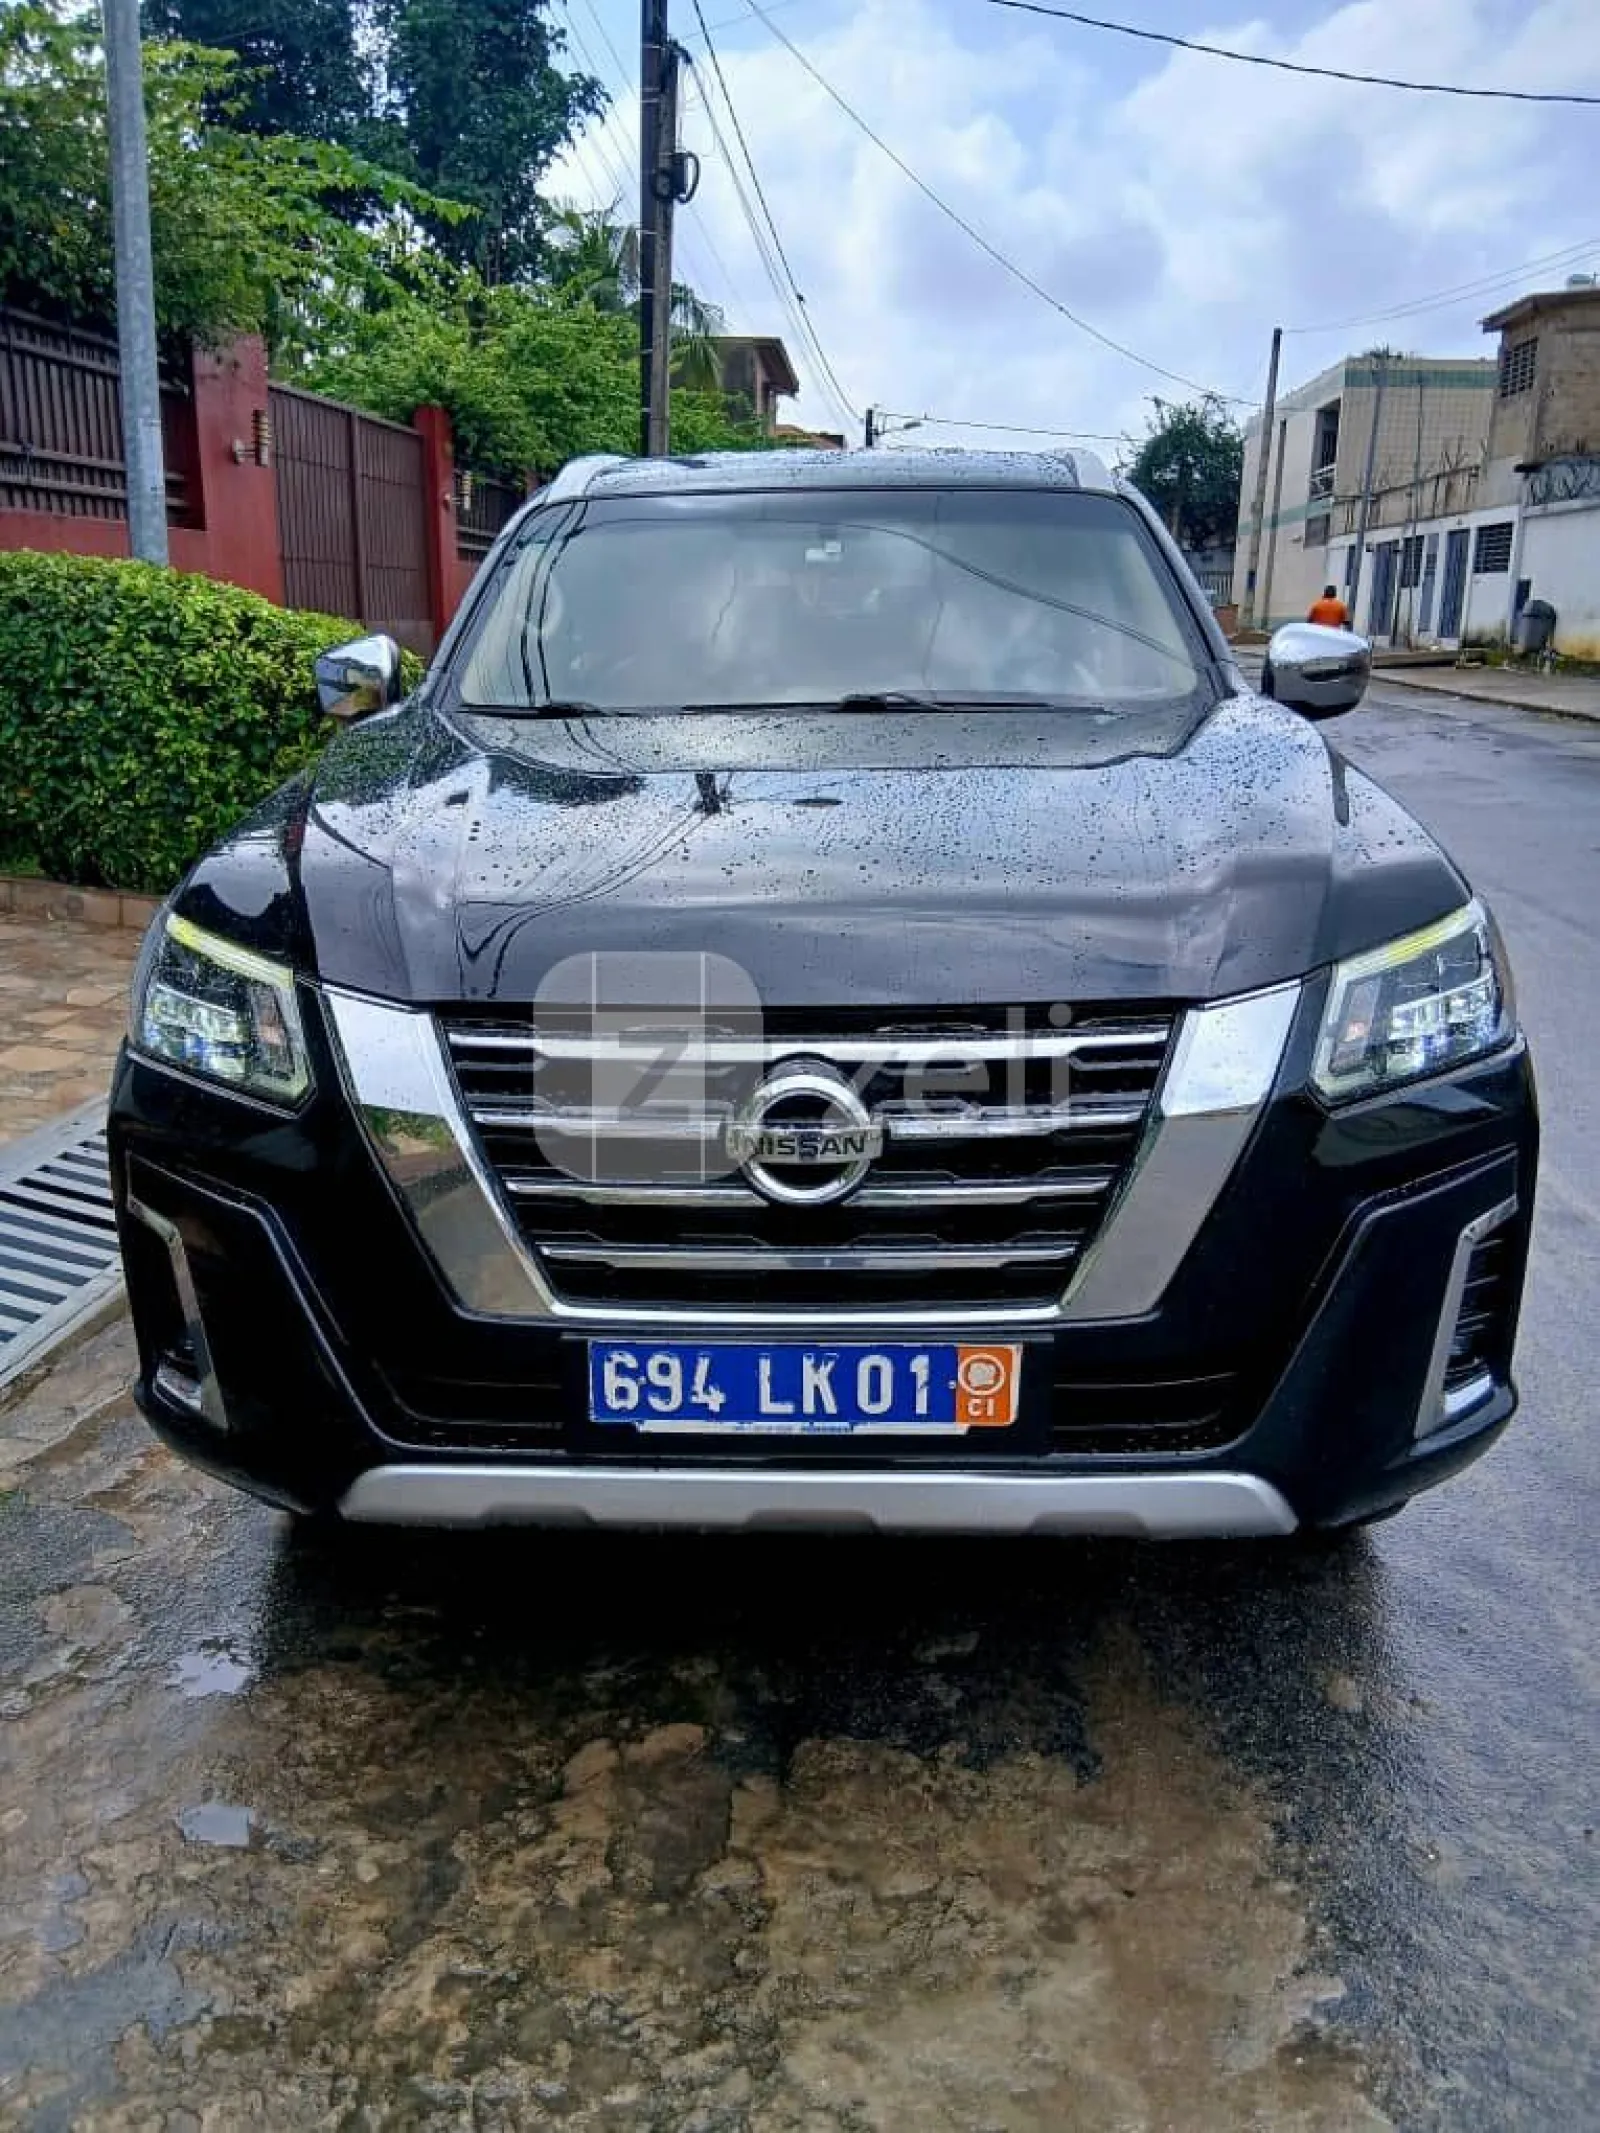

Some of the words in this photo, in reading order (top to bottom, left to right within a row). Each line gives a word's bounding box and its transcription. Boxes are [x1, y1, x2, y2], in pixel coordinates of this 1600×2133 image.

[745, 1135, 866, 1156] NISSAN
[603, 1351, 726, 1412] 694
[967, 1398, 995, 1417] CI
